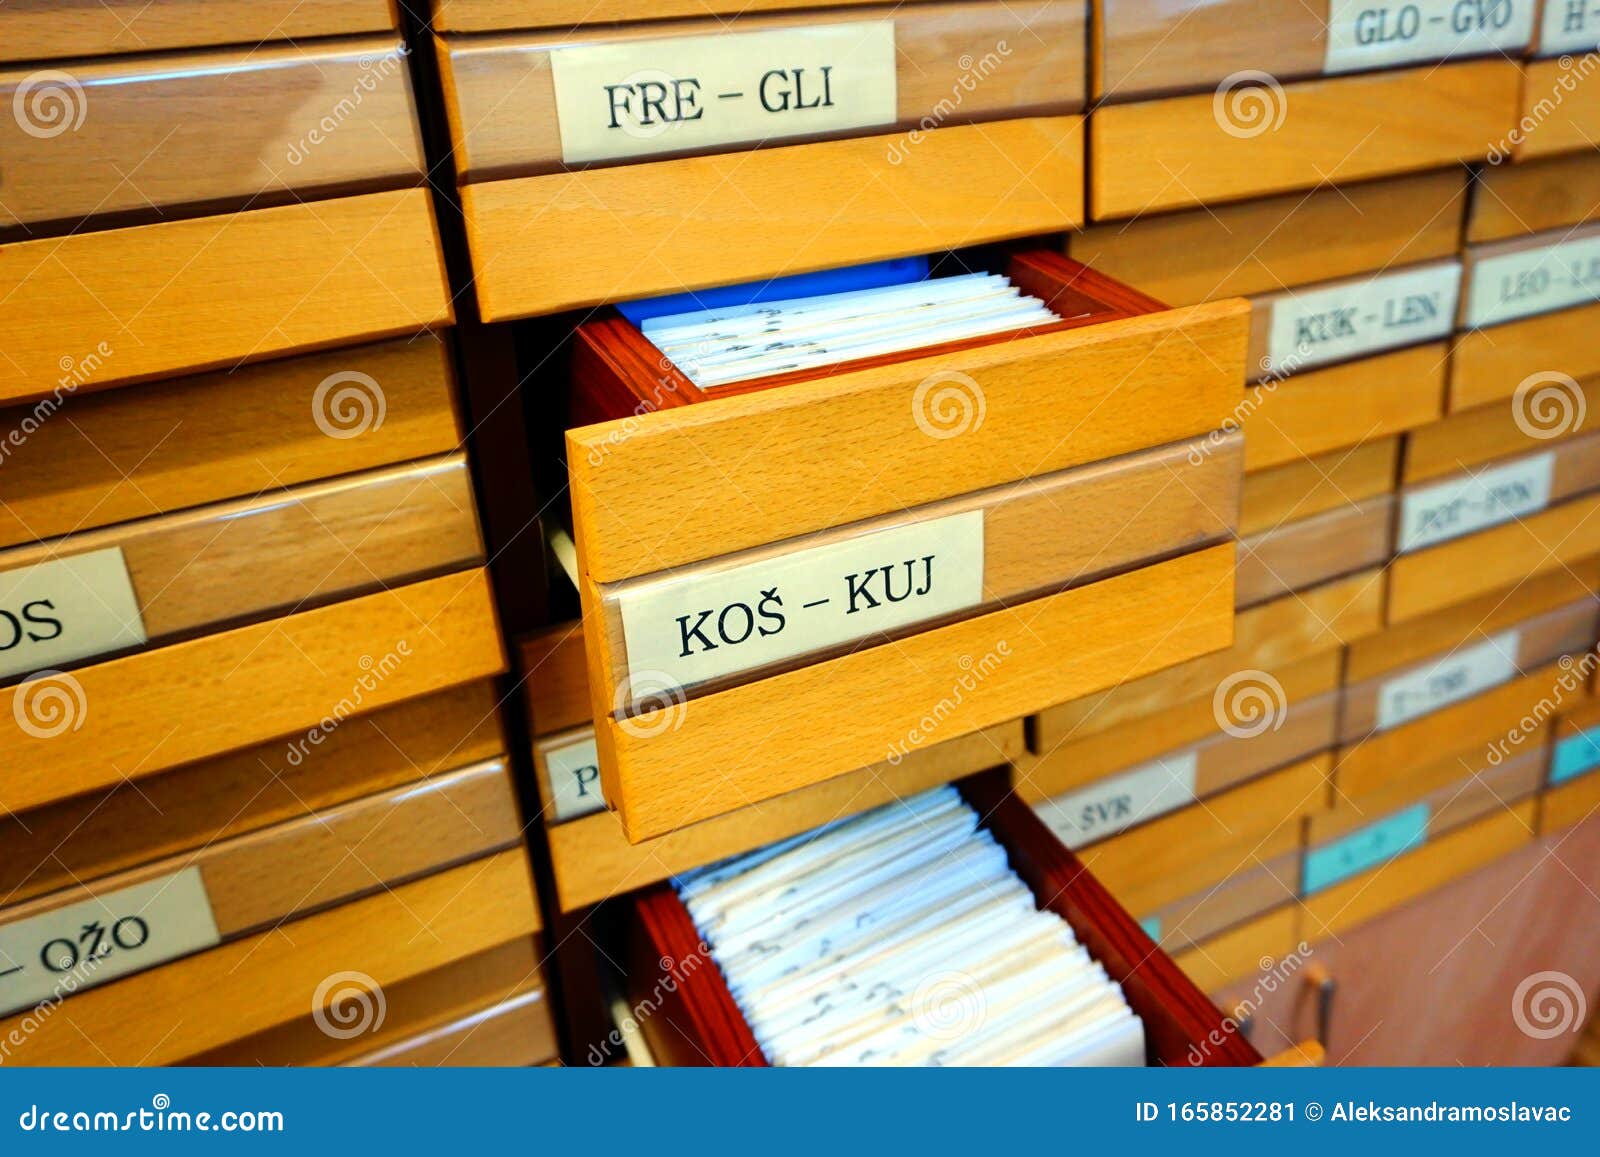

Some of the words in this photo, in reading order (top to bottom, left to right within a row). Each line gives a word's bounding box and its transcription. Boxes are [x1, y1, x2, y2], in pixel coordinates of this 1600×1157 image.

[1355, 5, 1420, 45] GLO
[604, 78, 704, 129] FRE
[759, 66, 835, 113] GLI
[675, 587, 786, 657] KOŠ
[844, 555, 936, 614] KUJ
[40, 915, 149, 972] OŽO
